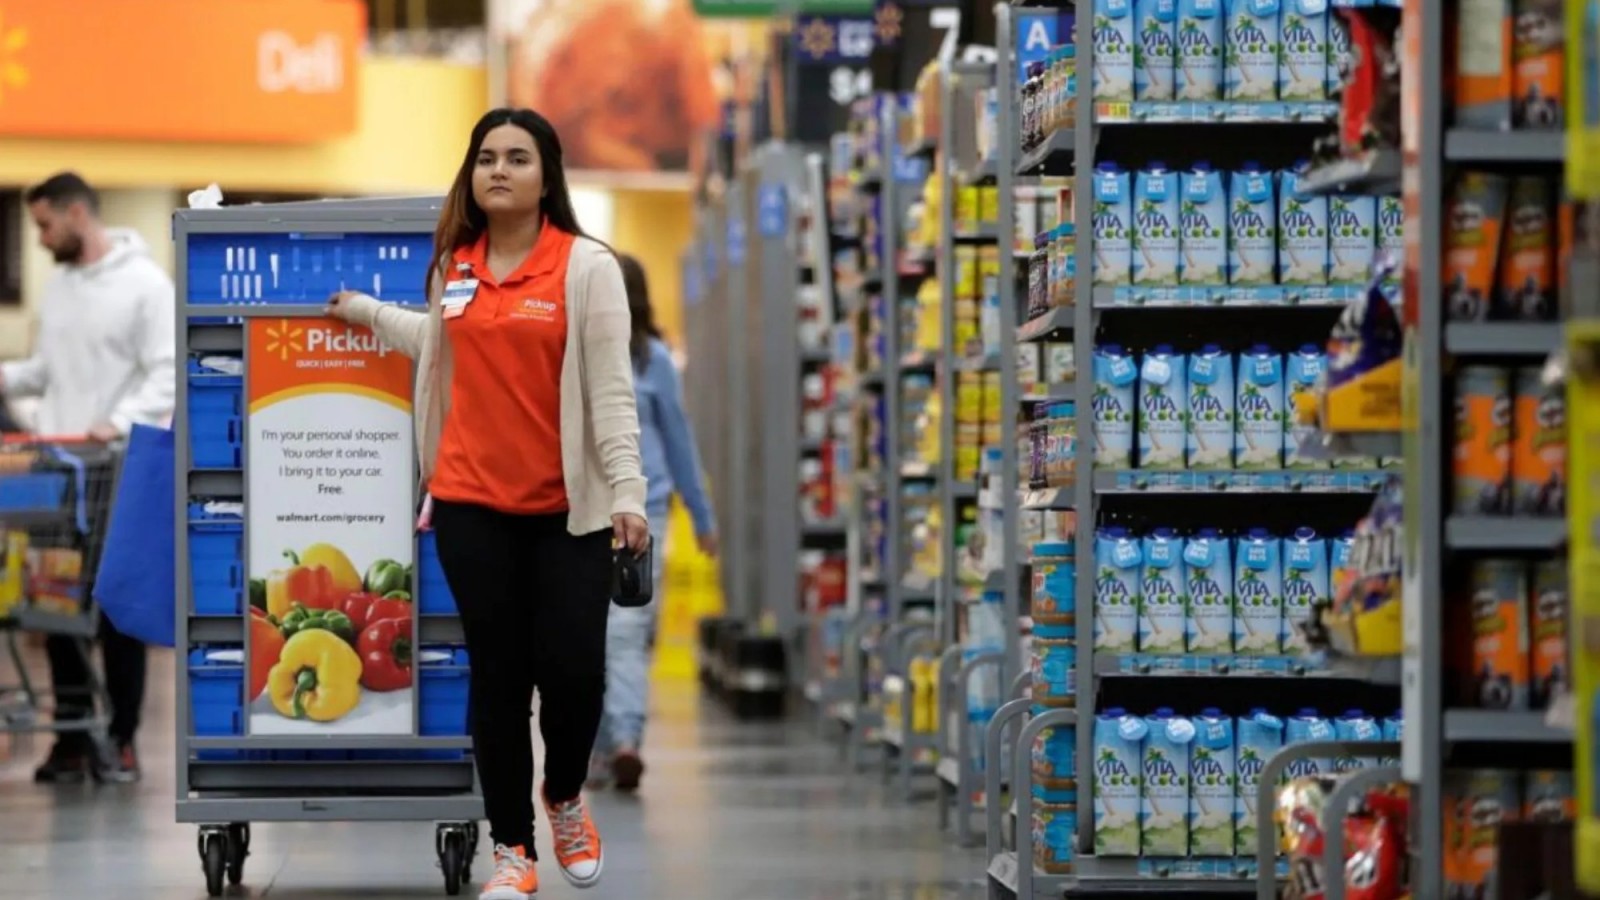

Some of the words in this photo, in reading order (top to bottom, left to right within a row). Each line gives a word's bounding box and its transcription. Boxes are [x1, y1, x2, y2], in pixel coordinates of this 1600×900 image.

[1025, 20, 1050, 51] A
[1141, 30, 1172, 47] VITA
[1179, 30, 1211, 47] VITA
[1234, 26, 1266, 44] VITA
[1283, 27, 1317, 44] VITA
[257, 32, 342, 92] Deli
[1092, 211, 1123, 229] VITA
[1136, 211, 1170, 229] VITA
[1180, 212, 1211, 229] VITA
[1232, 211, 1264, 228] VITA
[1282, 211, 1316, 228] VITA
[1329, 211, 1360, 228] VITA
[296, 359, 319, 368] QUICK
[324, 359, 343, 368] EASY
[1091, 393, 1122, 411] VITA
[1144, 393, 1176, 411] VITA
[1190, 393, 1223, 412] VITA
[1240, 394, 1272, 411] VITA
[261, 429, 278, 441] I'm
[280, 431, 304, 443] your
[306, 429, 353, 442] personal
[355, 428, 401, 443] shopper.
[282, 448, 303, 459] You
[305, 448, 334, 459] order
[336, 448, 343, 459] it
[285, 465, 314, 479] bring
[316, 466, 323, 476] it
[325, 466, 337, 477] to
[339, 467, 363, 479] your
[365, 467, 383, 477] car.
[317, 483, 344, 495] Free.
[276, 512, 386, 524] walmart.com/grocery
[1096, 578, 1129, 596] VITA
[1142, 578, 1176, 596] VITA
[1188, 579, 1222, 596] VITA
[1237, 579, 1270, 597] VITA
[1283, 580, 1317, 597] VITA
[1097, 759, 1129, 776] VITA
[1143, 759, 1177, 776] VITA
[1190, 759, 1224, 776] VITA
